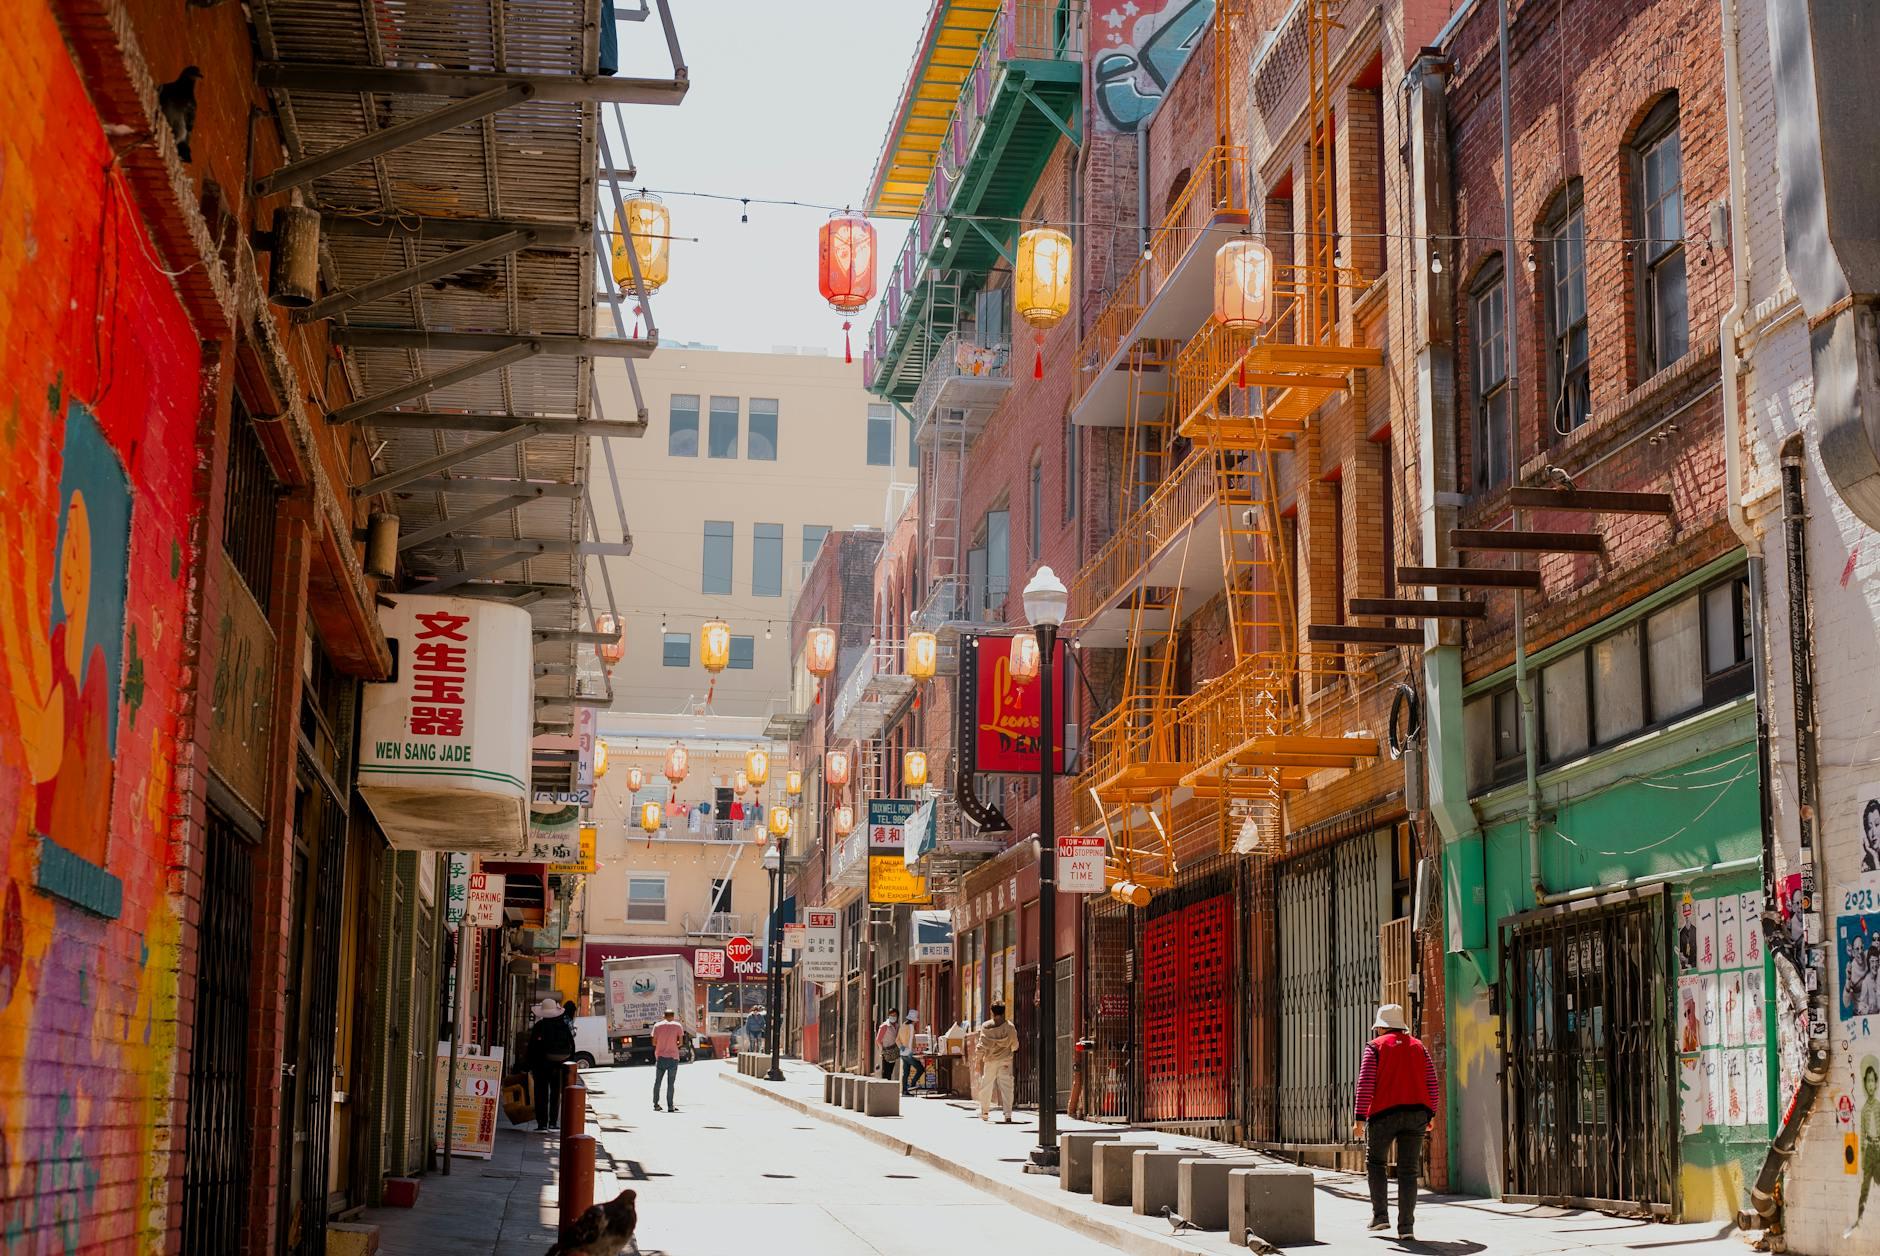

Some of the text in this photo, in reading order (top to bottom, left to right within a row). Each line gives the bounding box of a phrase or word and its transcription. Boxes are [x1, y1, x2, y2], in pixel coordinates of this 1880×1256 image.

[410, 611, 470, 737] 文生玉器
[1000, 733, 1041, 753] DEN
[375, 741, 472, 762] WEN SANG JADE
[874, 827, 904, 843] 德和
[1065, 838, 1099, 846] TOW-AWAY
[1060, 845, 1104, 857] NO STOPPING
[1072, 862, 1092, 870] ANY
[1070, 871, 1093, 880] TIME
[472, 876, 484, 889] NO
[471, 891, 501, 903] PARKING
[1845, 889, 1873, 910] 2023
[478, 903, 493, 911] ANY
[477, 912, 494, 921] TIME
[728, 944, 751, 955] STOP
[733, 961, 762, 973] HON'S
[1862, 1018, 1870, 1036] R
[475, 1079, 489, 1096] 9
